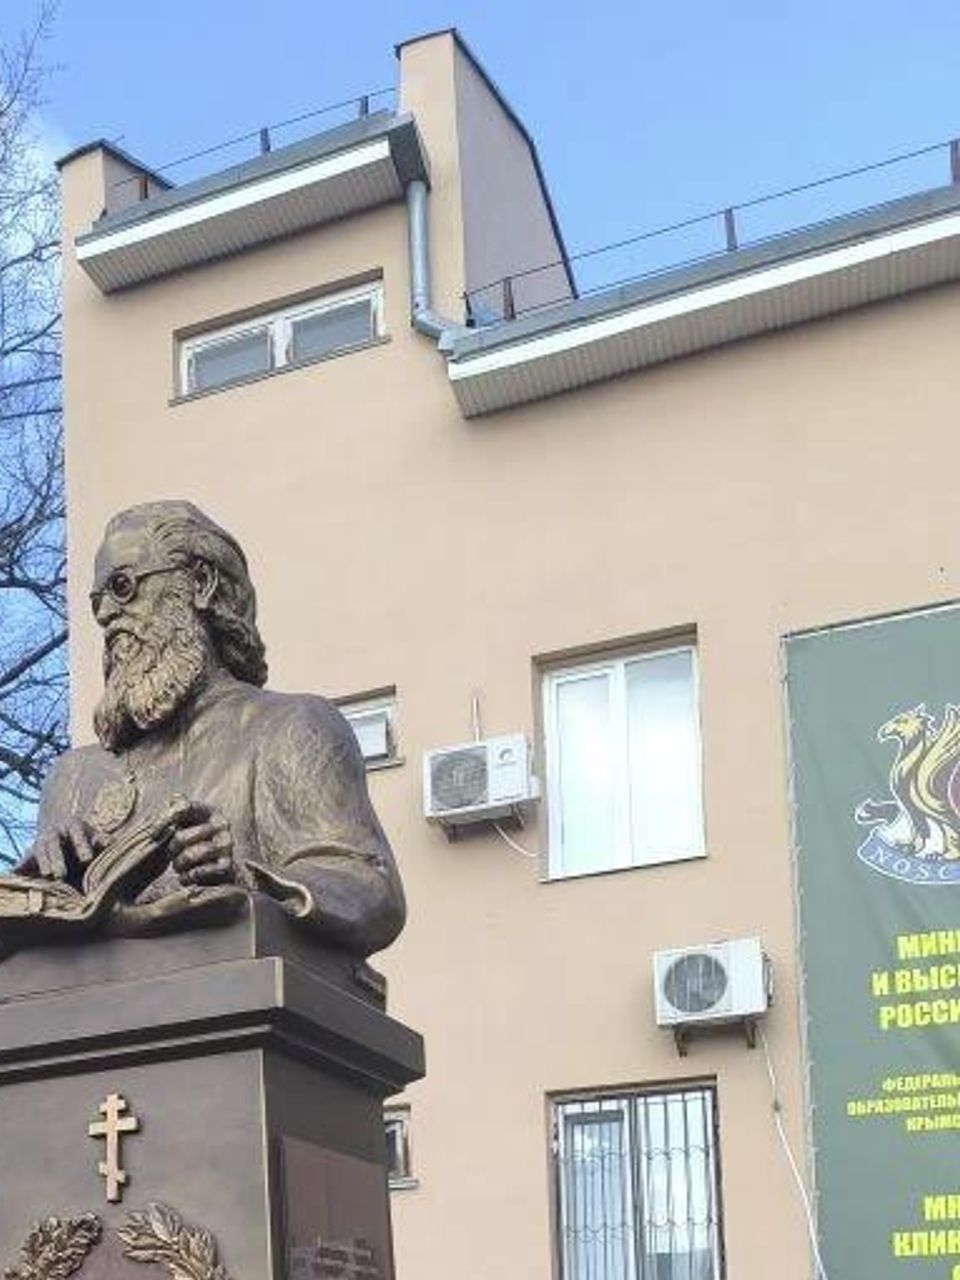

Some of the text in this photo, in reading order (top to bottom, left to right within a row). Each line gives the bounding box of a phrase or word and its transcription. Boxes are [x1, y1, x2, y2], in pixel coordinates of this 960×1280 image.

[872, 963, 960, 996] И ВЫС
[847, 1091, 960, 1115] ОБРАЗОВАТЕЛЬ
